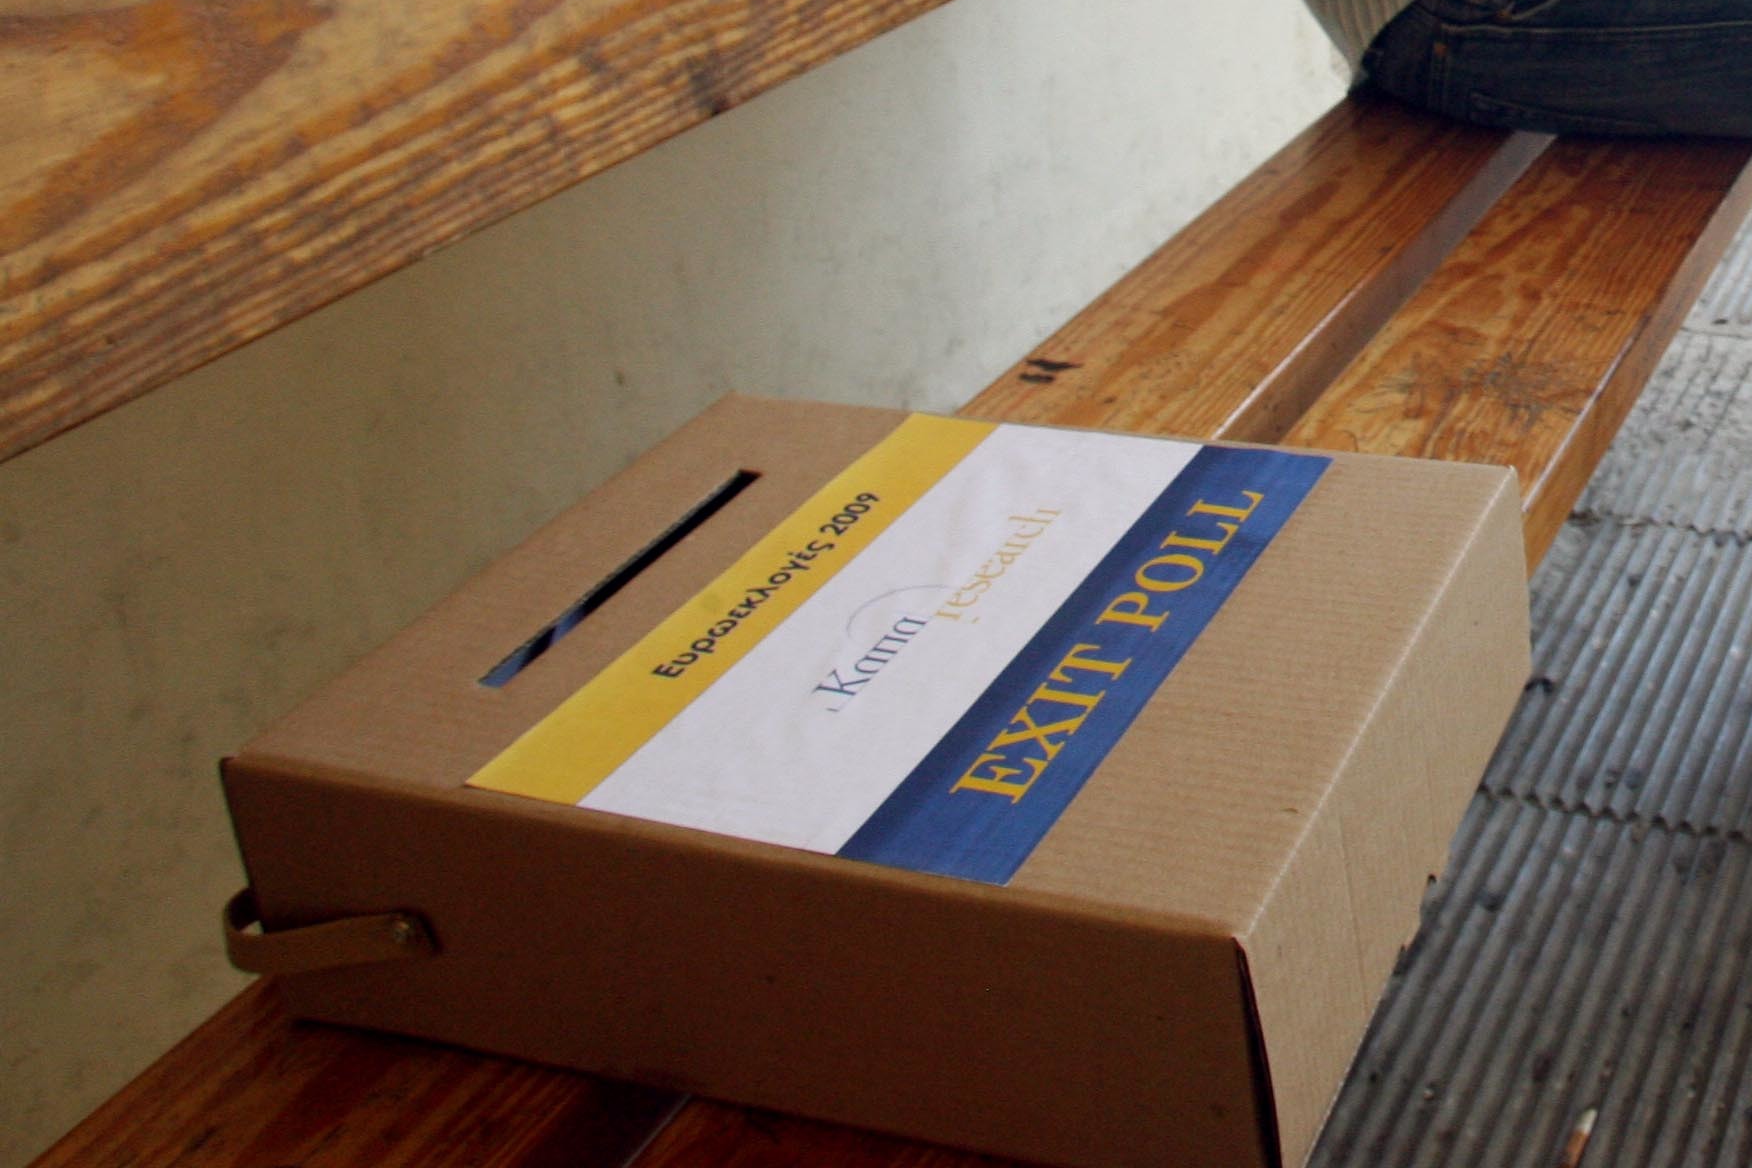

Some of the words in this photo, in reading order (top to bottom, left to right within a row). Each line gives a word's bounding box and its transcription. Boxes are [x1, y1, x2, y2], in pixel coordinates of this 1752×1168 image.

[652, 539, 836, 678] Ευρωεκλογές
[819, 492, 881, 537] 2009
[950, 643, 1133, 804] EXIT
[1094, 489, 1265, 632] POLL
